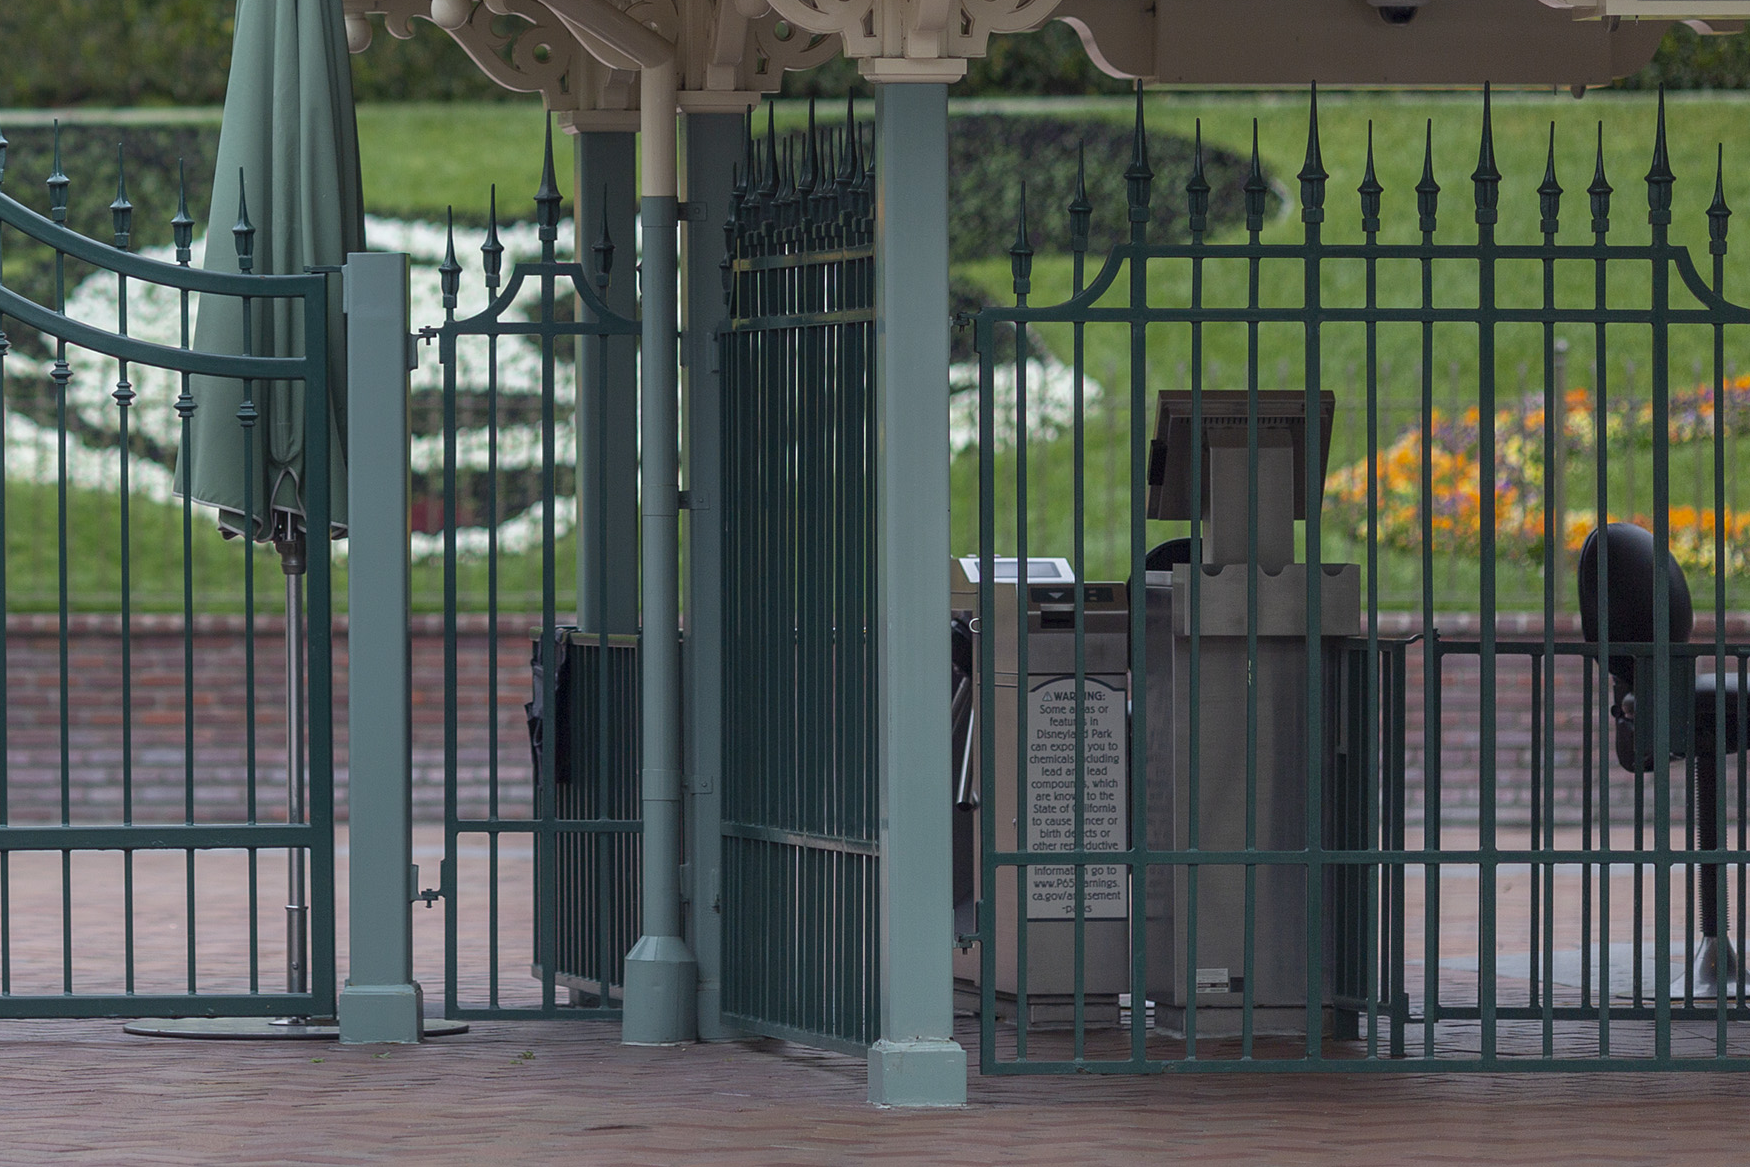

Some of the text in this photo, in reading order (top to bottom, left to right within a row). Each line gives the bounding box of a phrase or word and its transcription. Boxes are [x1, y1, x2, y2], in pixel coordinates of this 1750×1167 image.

[1054, 691, 1106, 701] WARING:
[1040, 705, 1109, 714] Some aas or
[1050, 717, 1098, 726] featurs in
[1037, 729, 1112, 740] Disneylad Park
[1030, 742, 1118, 753] can expo you to
[1083, 754, 1120, 764] cluding
[1041, 767, 1062, 776] lead
[1087, 767, 1108, 776] lead
[1031, 779, 1118, 790] compoun, which
[1035, 791, 1115, 801] are kno to the
[1033, 804, 1117, 813] State of lifornia
[1032, 817, 1118, 826] to cause ncer or
[1040, 829, 1111, 838] birth dects or
[1033, 841, 1118, 851] other repductive
[1034, 866, 1117, 876] informatin go to
[1033, 879, 1120, 888] www.P65arnings.
[1032, 891, 1121, 902] ca.gov/asement
[1062, 905, 1092, 914] -pas
